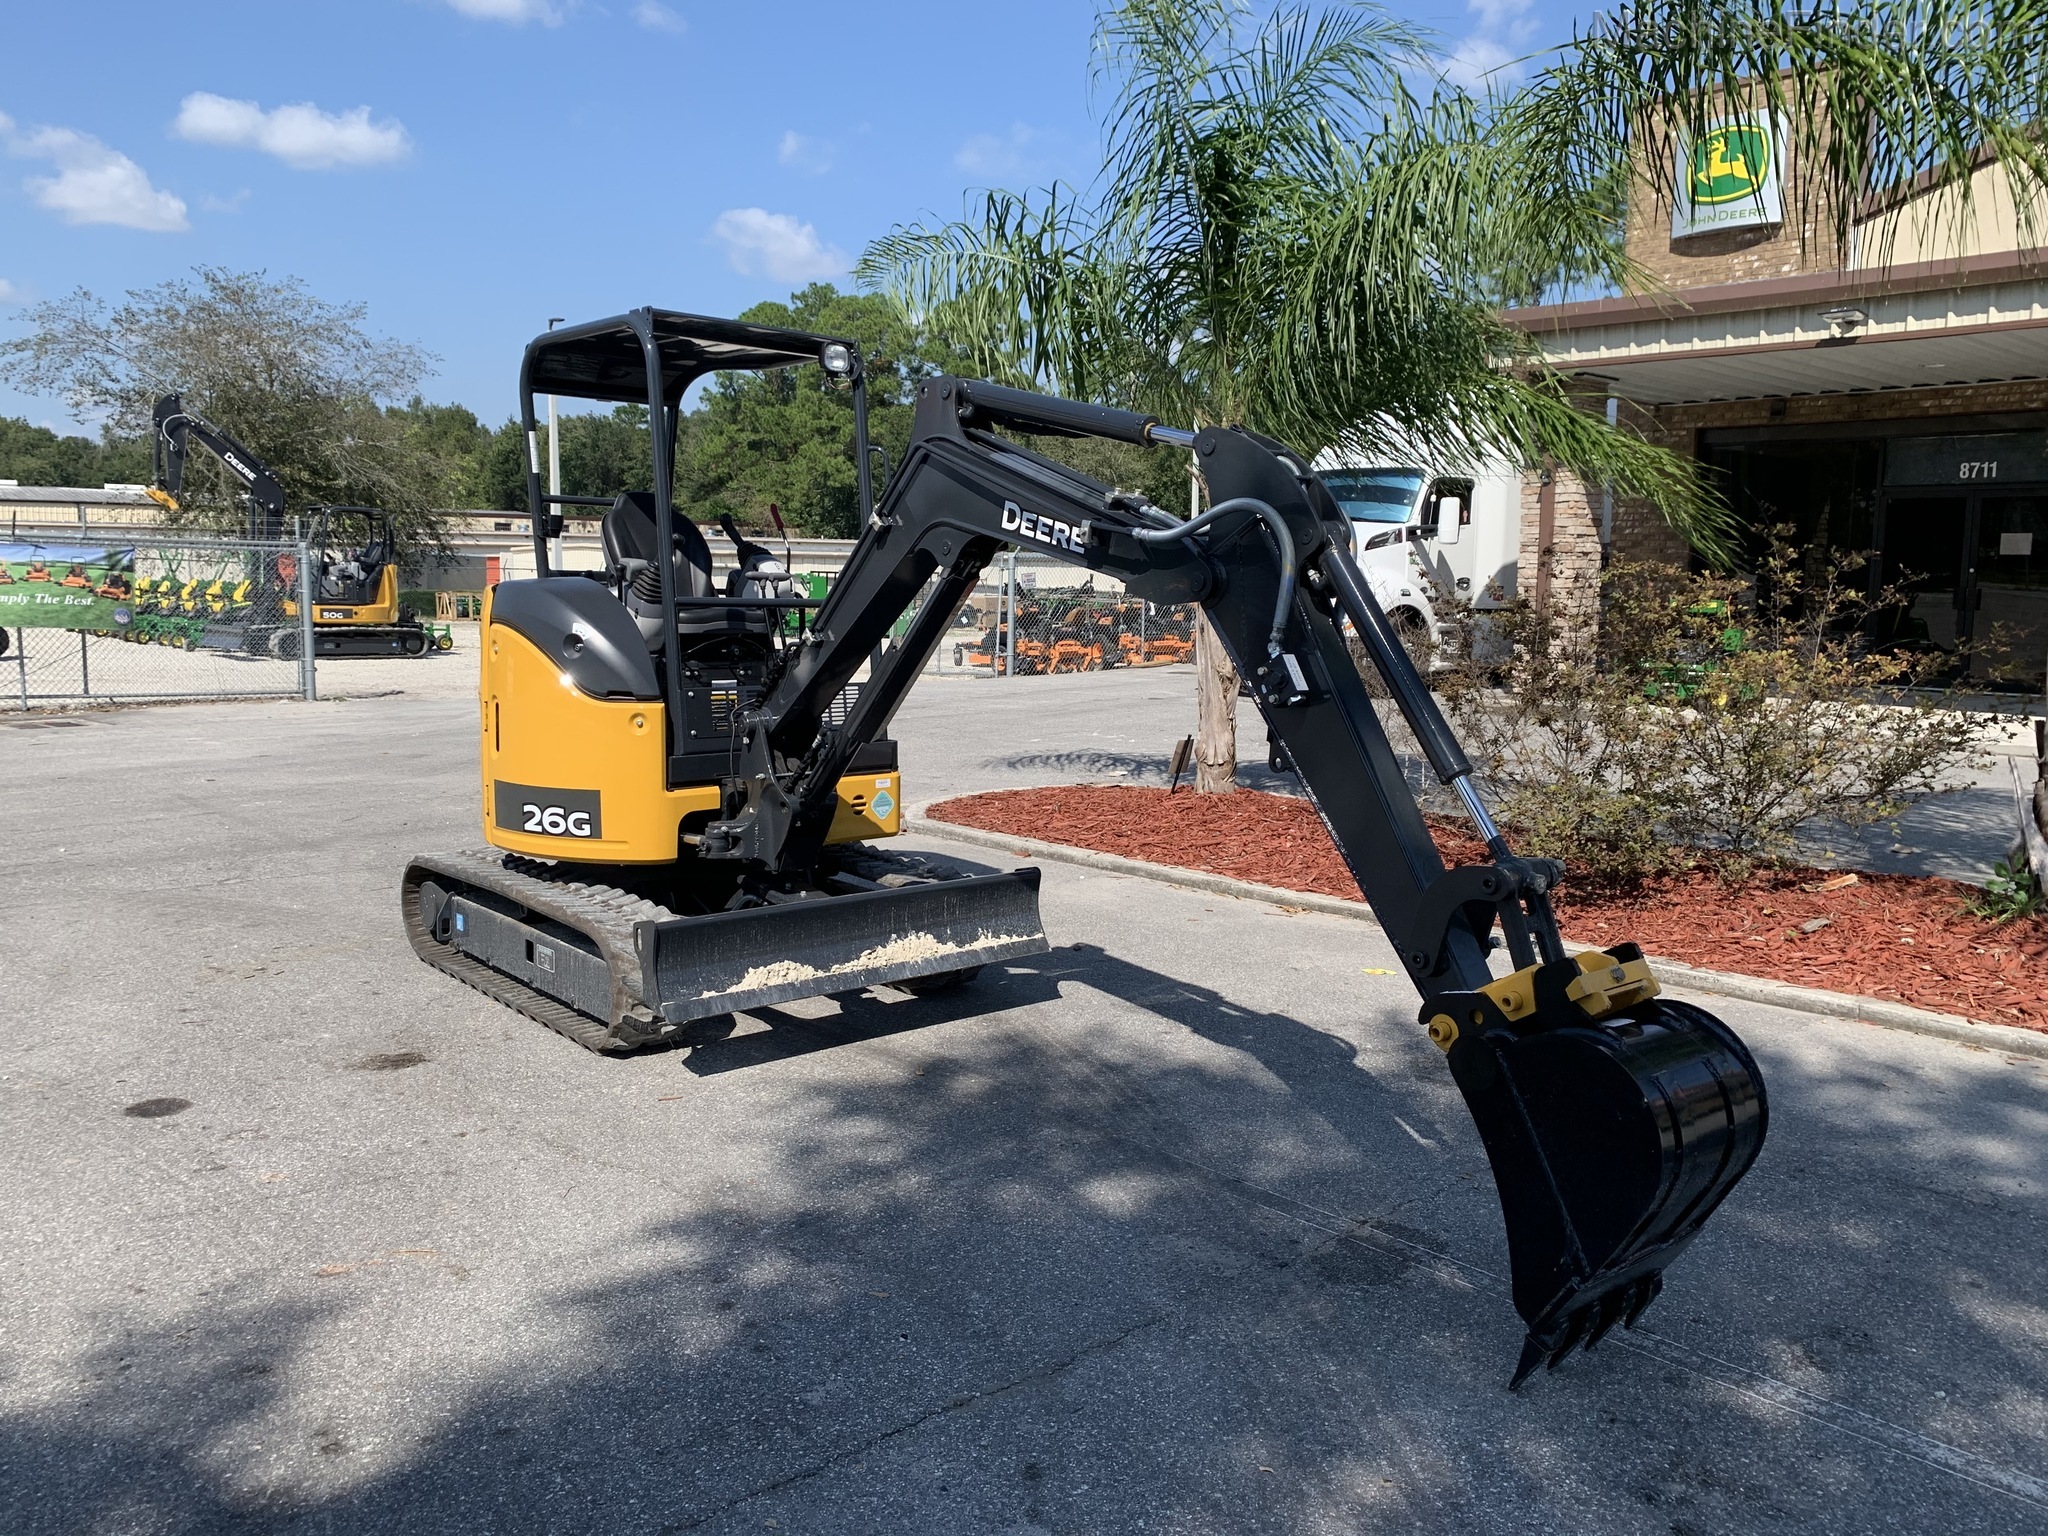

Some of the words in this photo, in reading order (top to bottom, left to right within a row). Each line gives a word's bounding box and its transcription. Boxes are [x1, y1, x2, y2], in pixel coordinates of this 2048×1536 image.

[1682, 214, 1717, 229] JOHN
[223, 452, 257, 481] DEERE
[1959, 461, 1997, 479] 8711
[1001, 500, 1085, 554] DEERE
[34, 593, 60, 605] The
[63, 594, 95, 606] Best.
[322, 611, 344, 619] 50G
[523, 804, 592, 837] 26G
